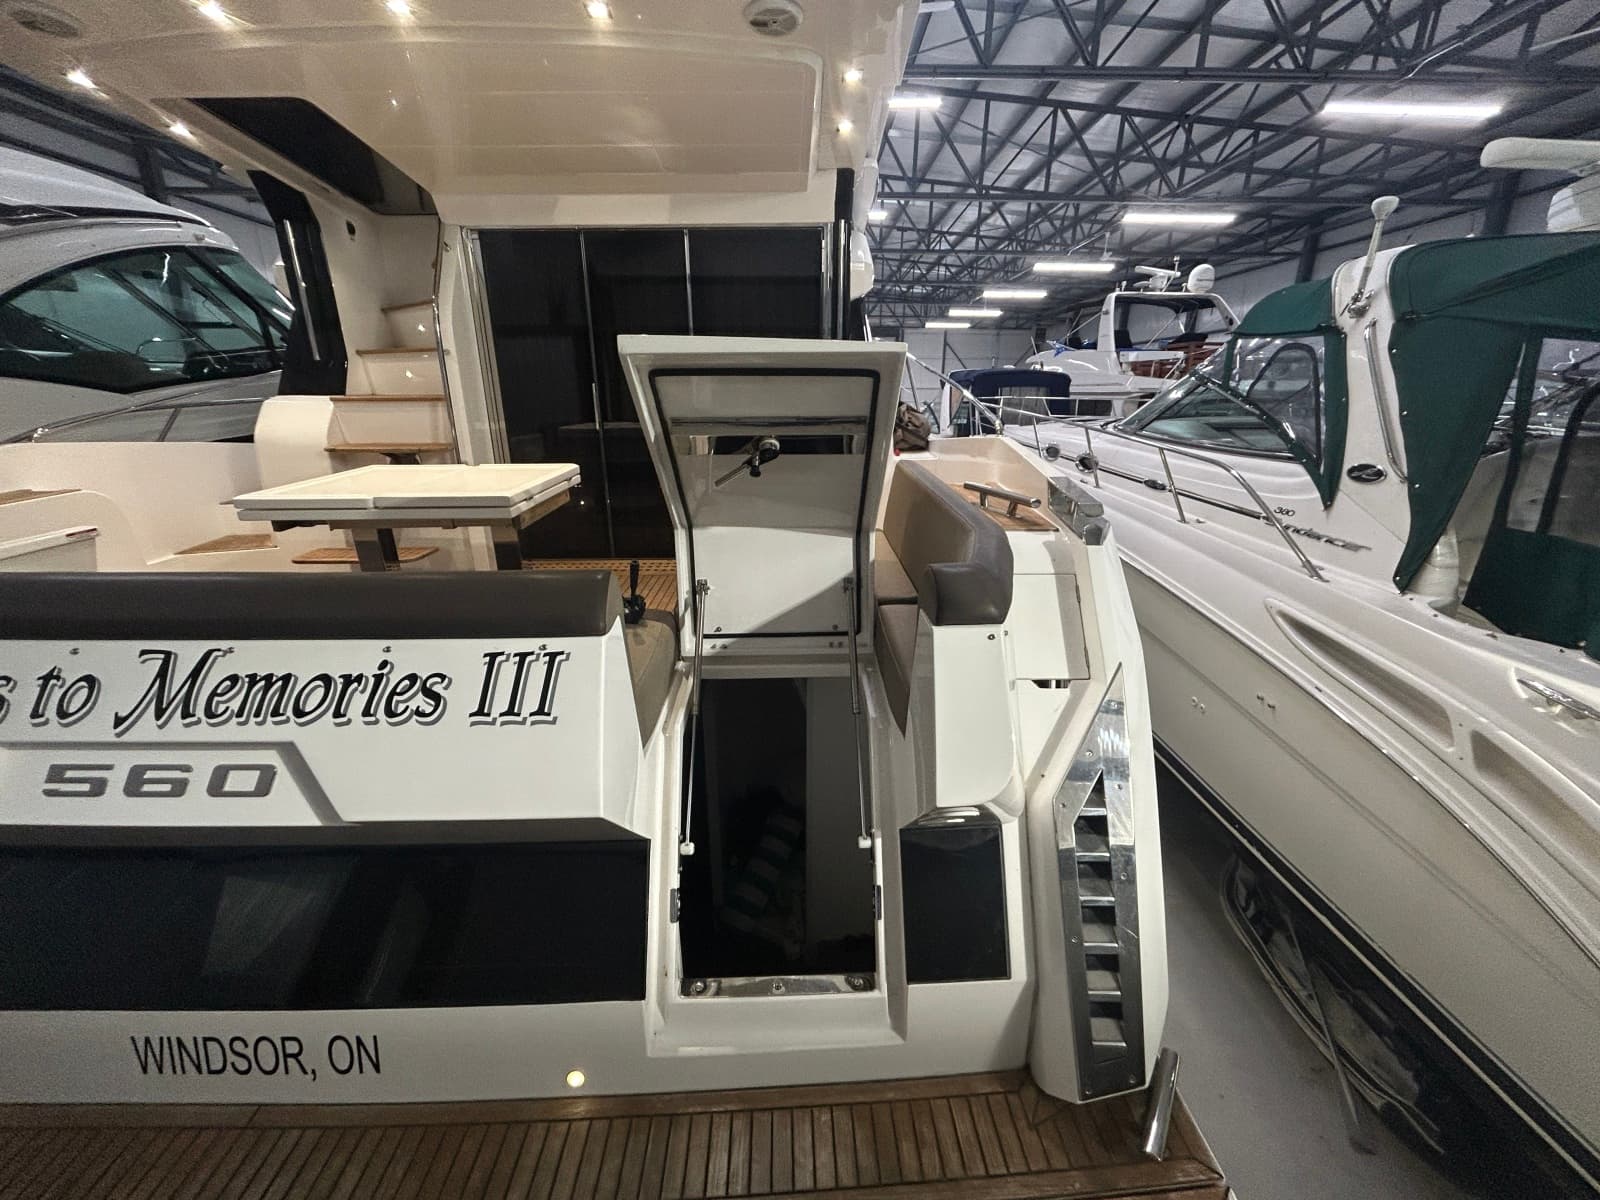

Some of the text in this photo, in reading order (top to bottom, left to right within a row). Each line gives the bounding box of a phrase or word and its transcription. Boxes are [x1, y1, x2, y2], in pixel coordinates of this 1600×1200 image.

[1273, 506, 1296, 517] 380
[29, 665, 102, 728] to
[113, 647, 452, 738] Memories
[468, 650, 571, 728] III
[42, 763, 278, 798] 560
[130, 1034, 381, 1082] WINDSOR, ON
